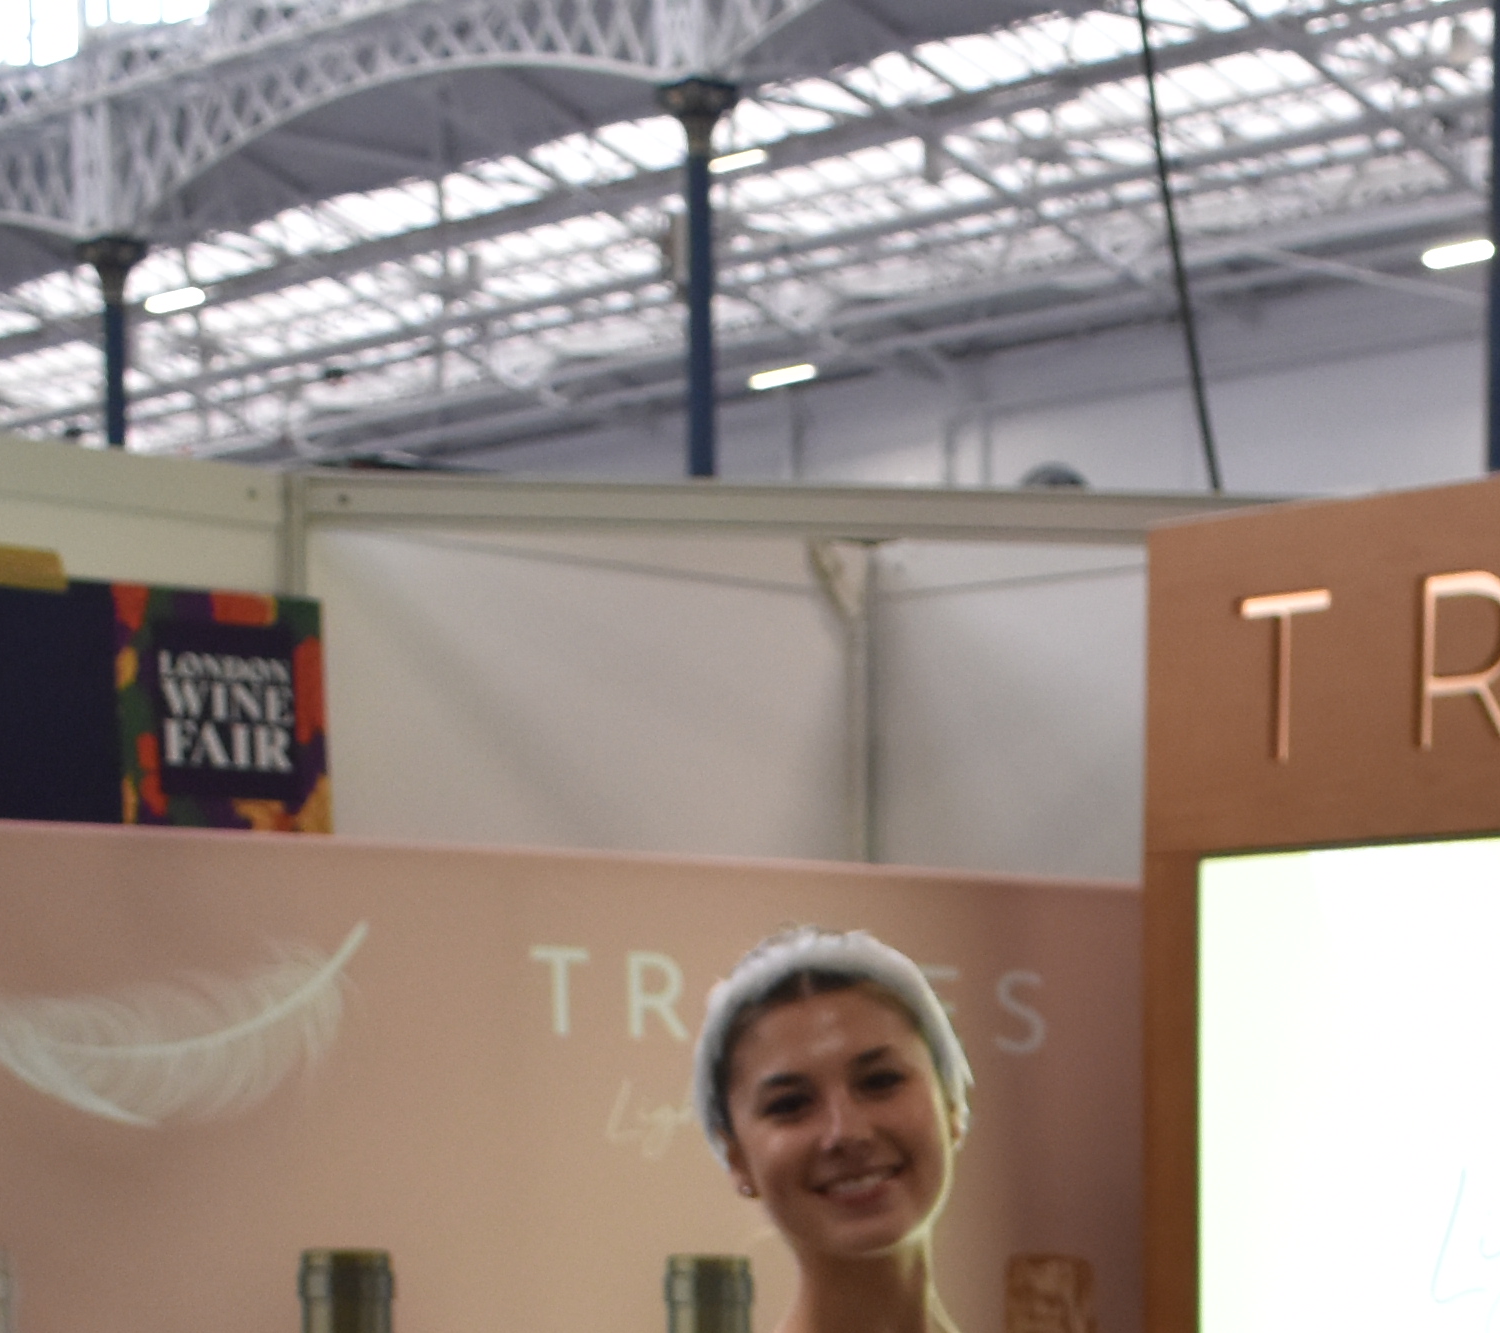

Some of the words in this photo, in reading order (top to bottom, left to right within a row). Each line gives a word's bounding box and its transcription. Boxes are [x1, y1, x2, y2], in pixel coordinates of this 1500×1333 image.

[159, 650, 291, 686] LONDON
[160, 677, 296, 727] WINE
[163, 716, 295, 774] FAIR
[529, 944, 1047, 1055] TRS
